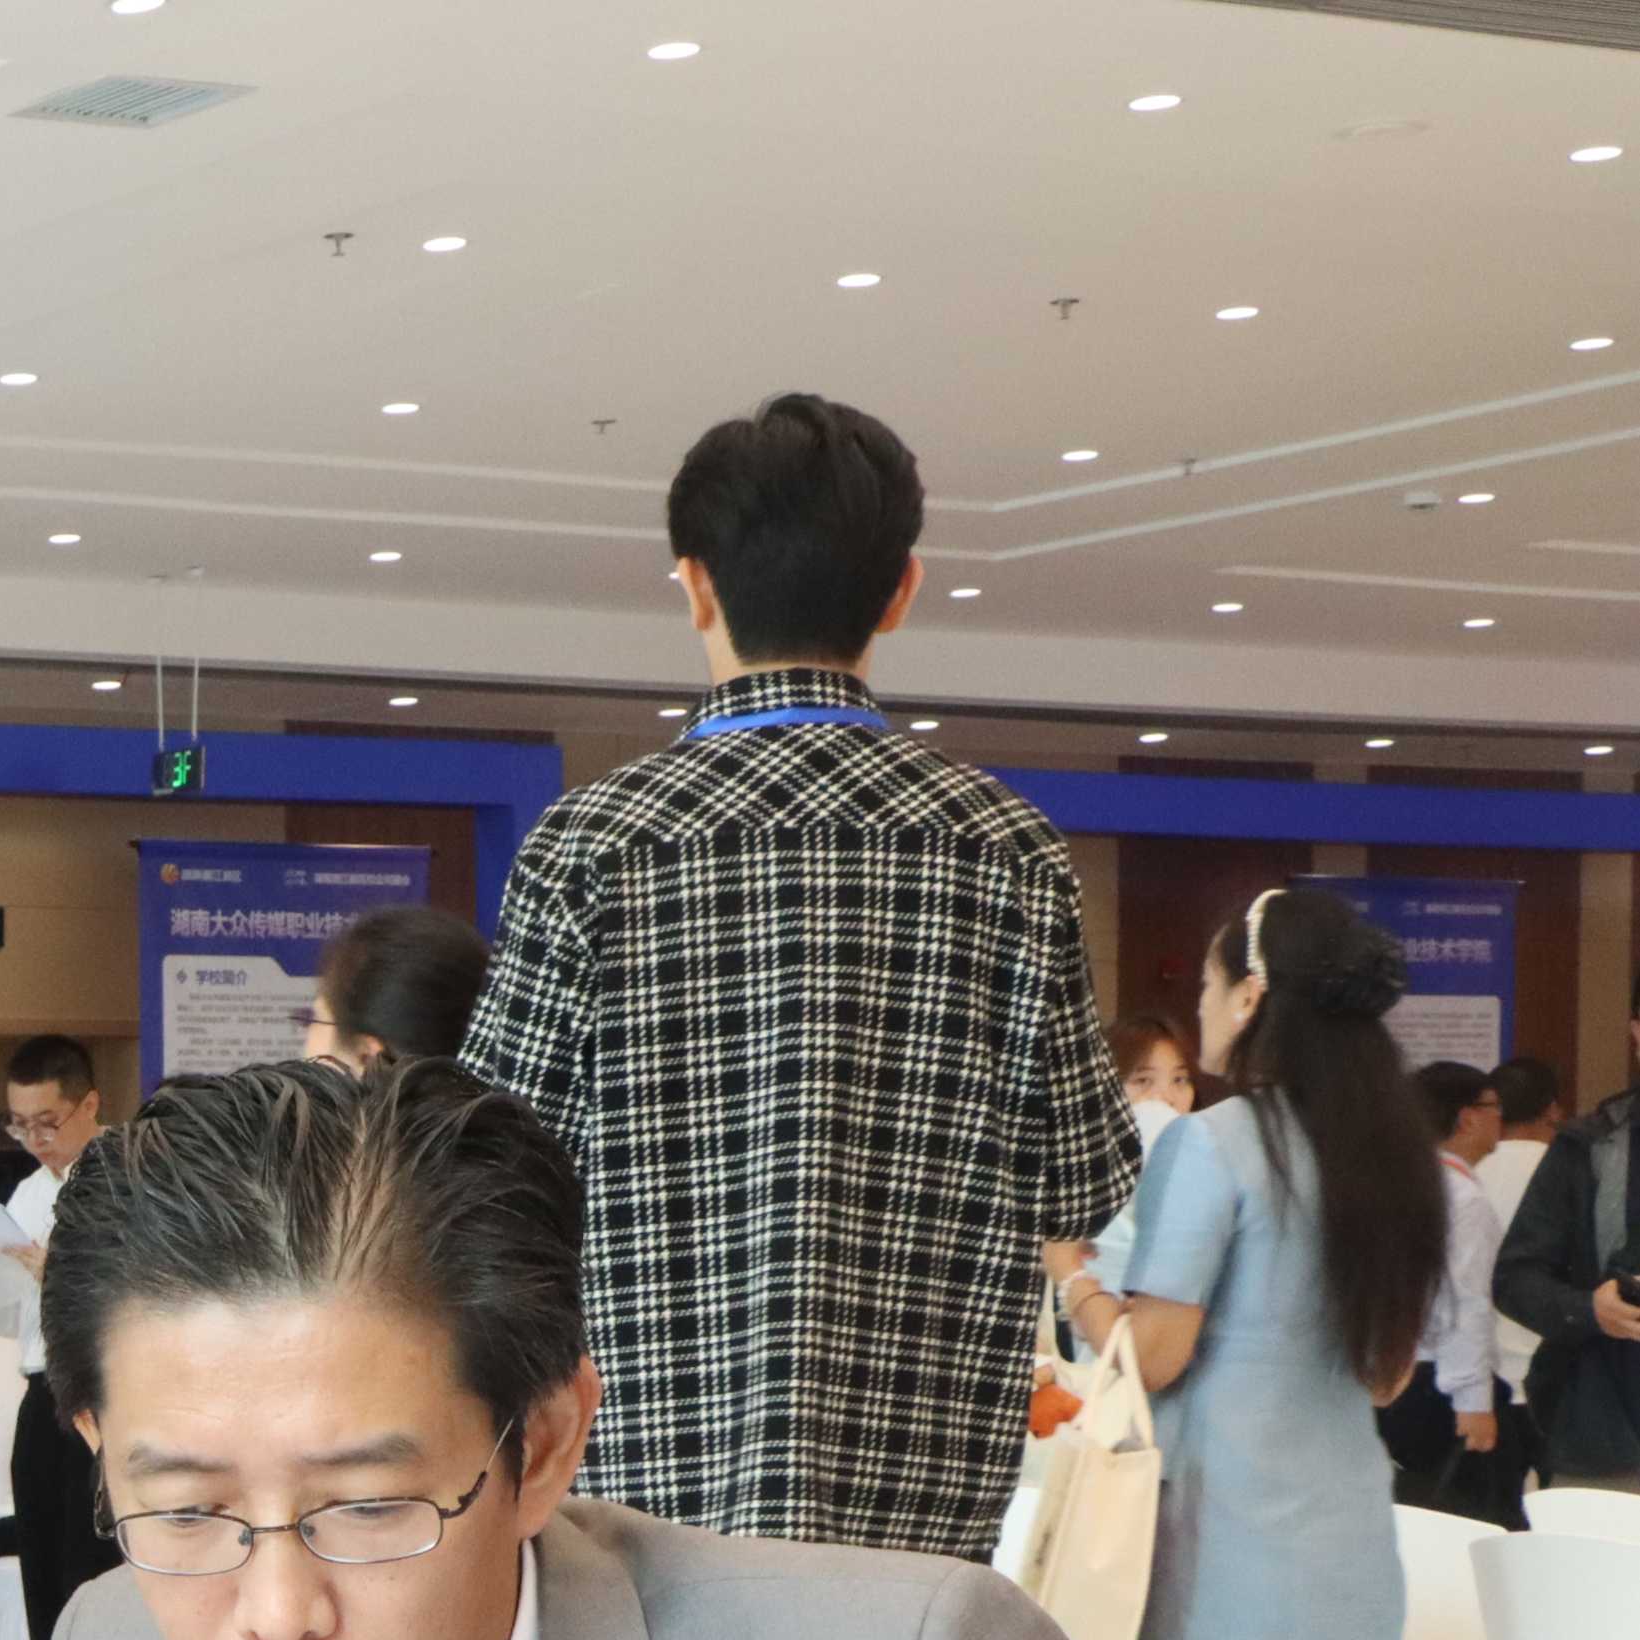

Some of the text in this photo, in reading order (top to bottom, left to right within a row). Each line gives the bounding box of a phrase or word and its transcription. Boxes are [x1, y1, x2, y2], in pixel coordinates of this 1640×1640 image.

[1389, 937, 1493, 963] 业技术学院
